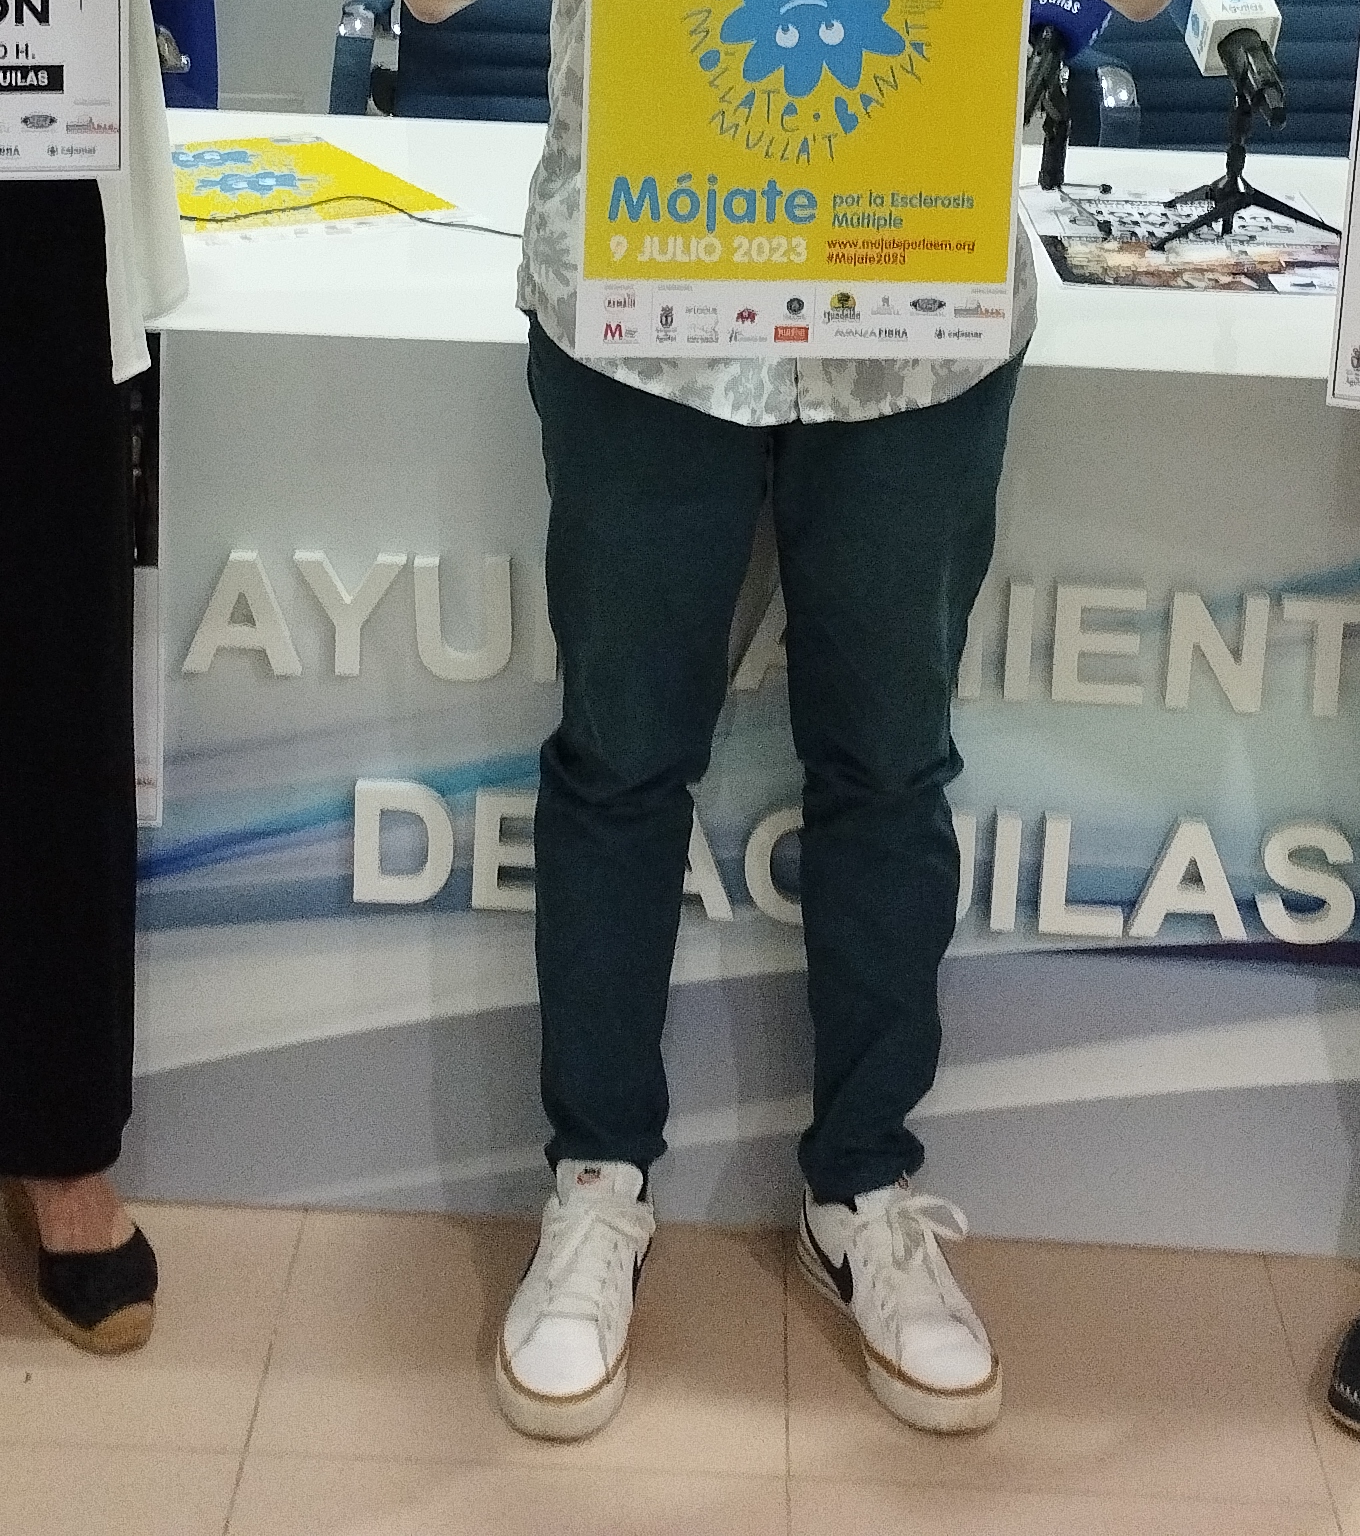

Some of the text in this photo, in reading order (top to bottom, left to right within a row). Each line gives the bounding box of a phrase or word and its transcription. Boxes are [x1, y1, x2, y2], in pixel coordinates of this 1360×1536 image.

[15, 44, 36, 62] H.
[608, 172, 975, 234] Mójate por la Esclerosis
[831, 210, 904, 232] Múltiple
[609, 234, 809, 264] 9 JULIO 2023
[352, 777, 1356, 947] DE AILAS
